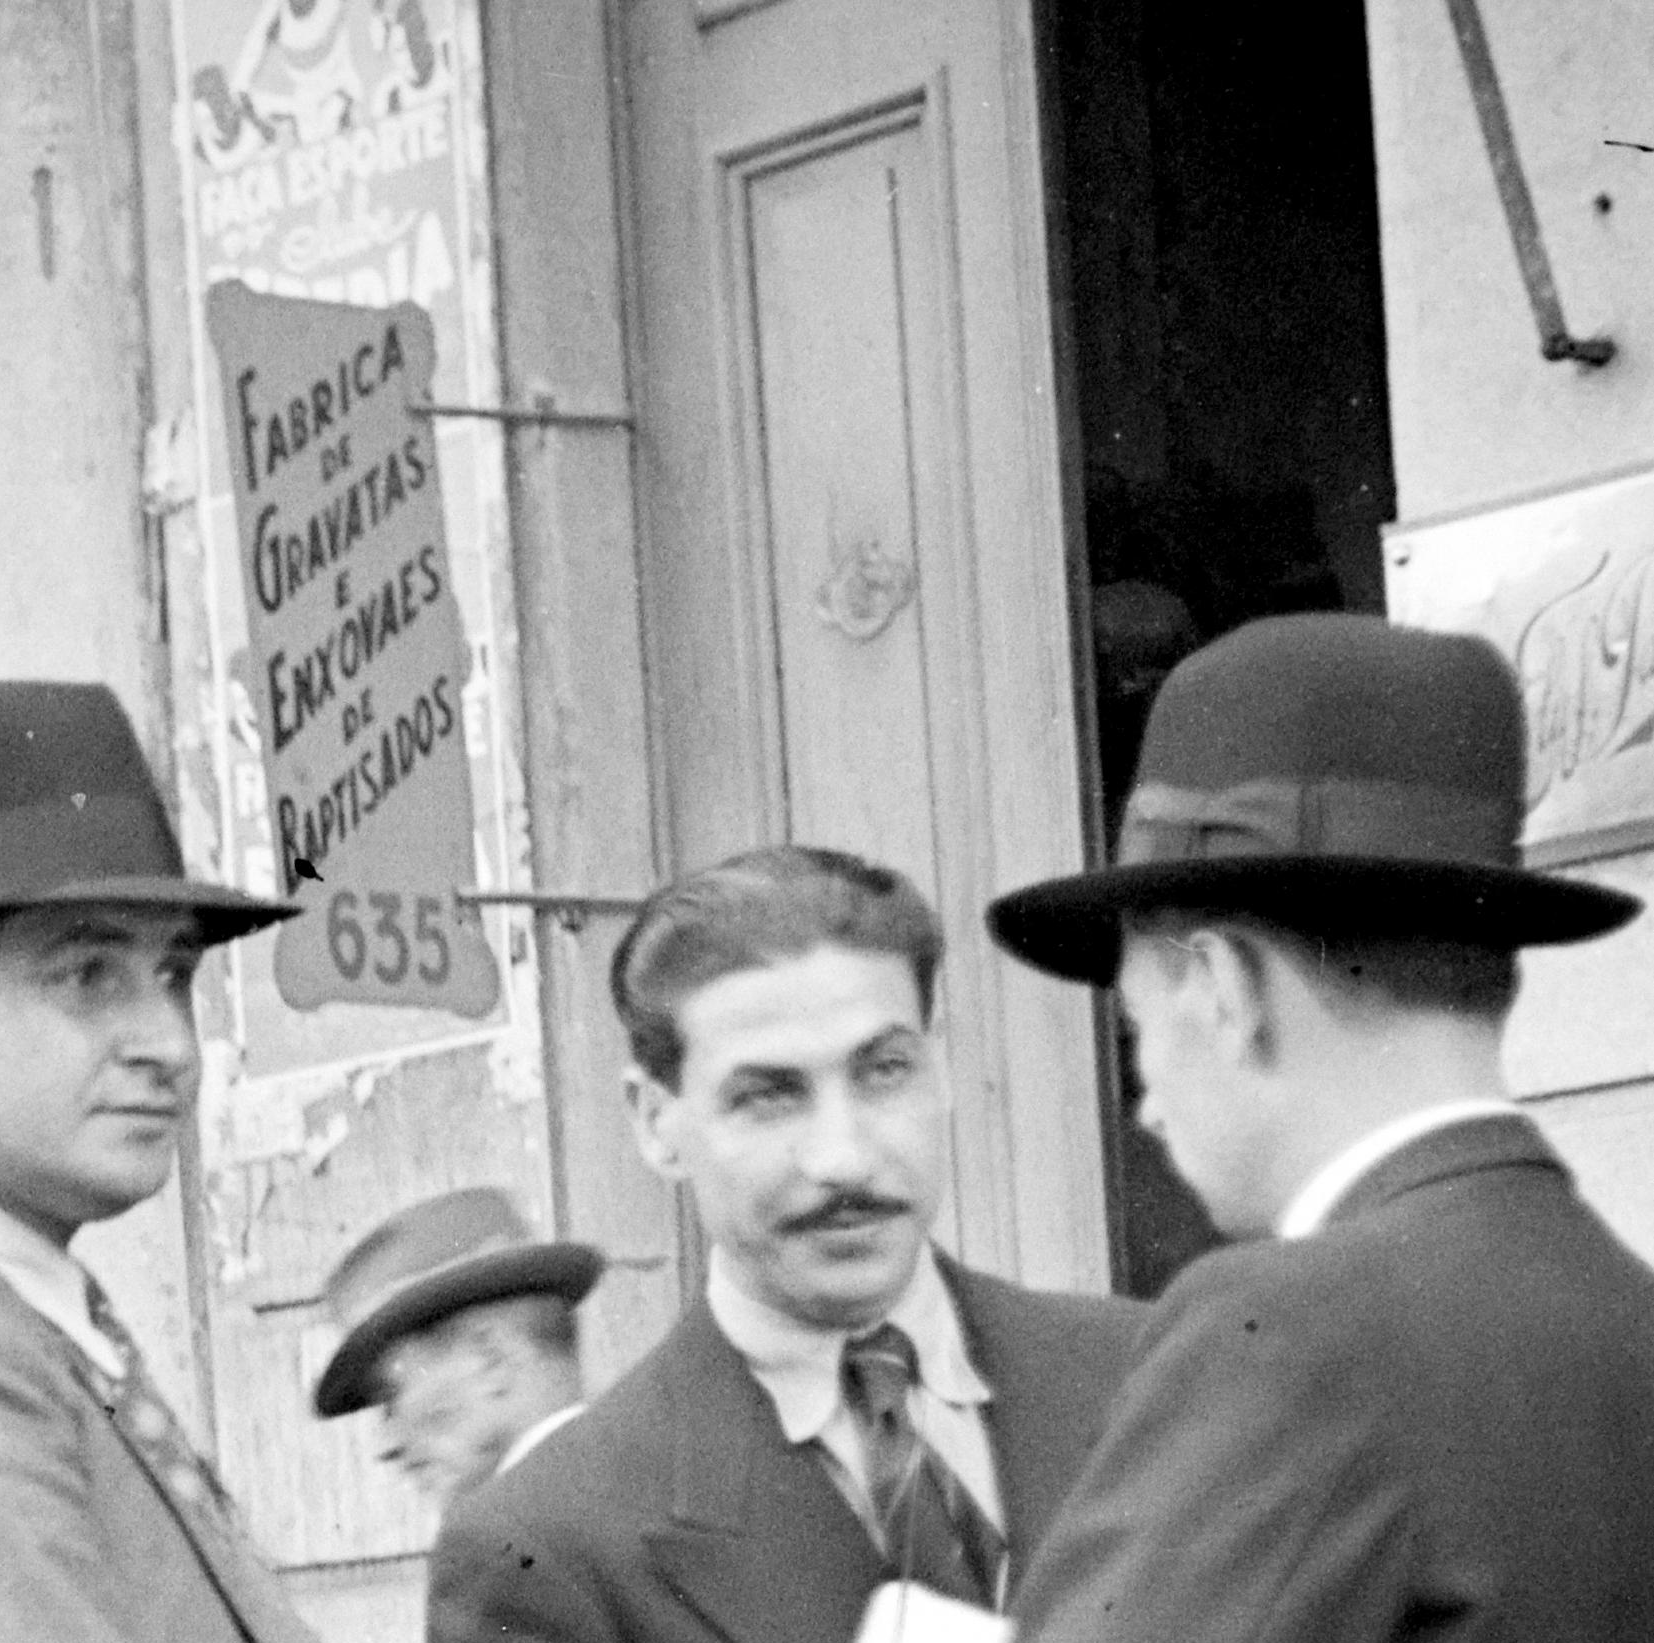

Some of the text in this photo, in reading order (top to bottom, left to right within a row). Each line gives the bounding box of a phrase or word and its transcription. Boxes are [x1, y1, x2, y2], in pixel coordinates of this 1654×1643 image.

[236, 322, 405, 493] FABRICA
[320, 433, 353, 483] DE
[253, 435, 427, 614] GRAVATAS
[335, 569, 352, 609] E
[266, 545, 441, 756] ENXOVAES
[342, 686, 375, 746] DE
[278, 674, 454, 897] BAPTISADOS
[326, 891, 451, 985] 635
